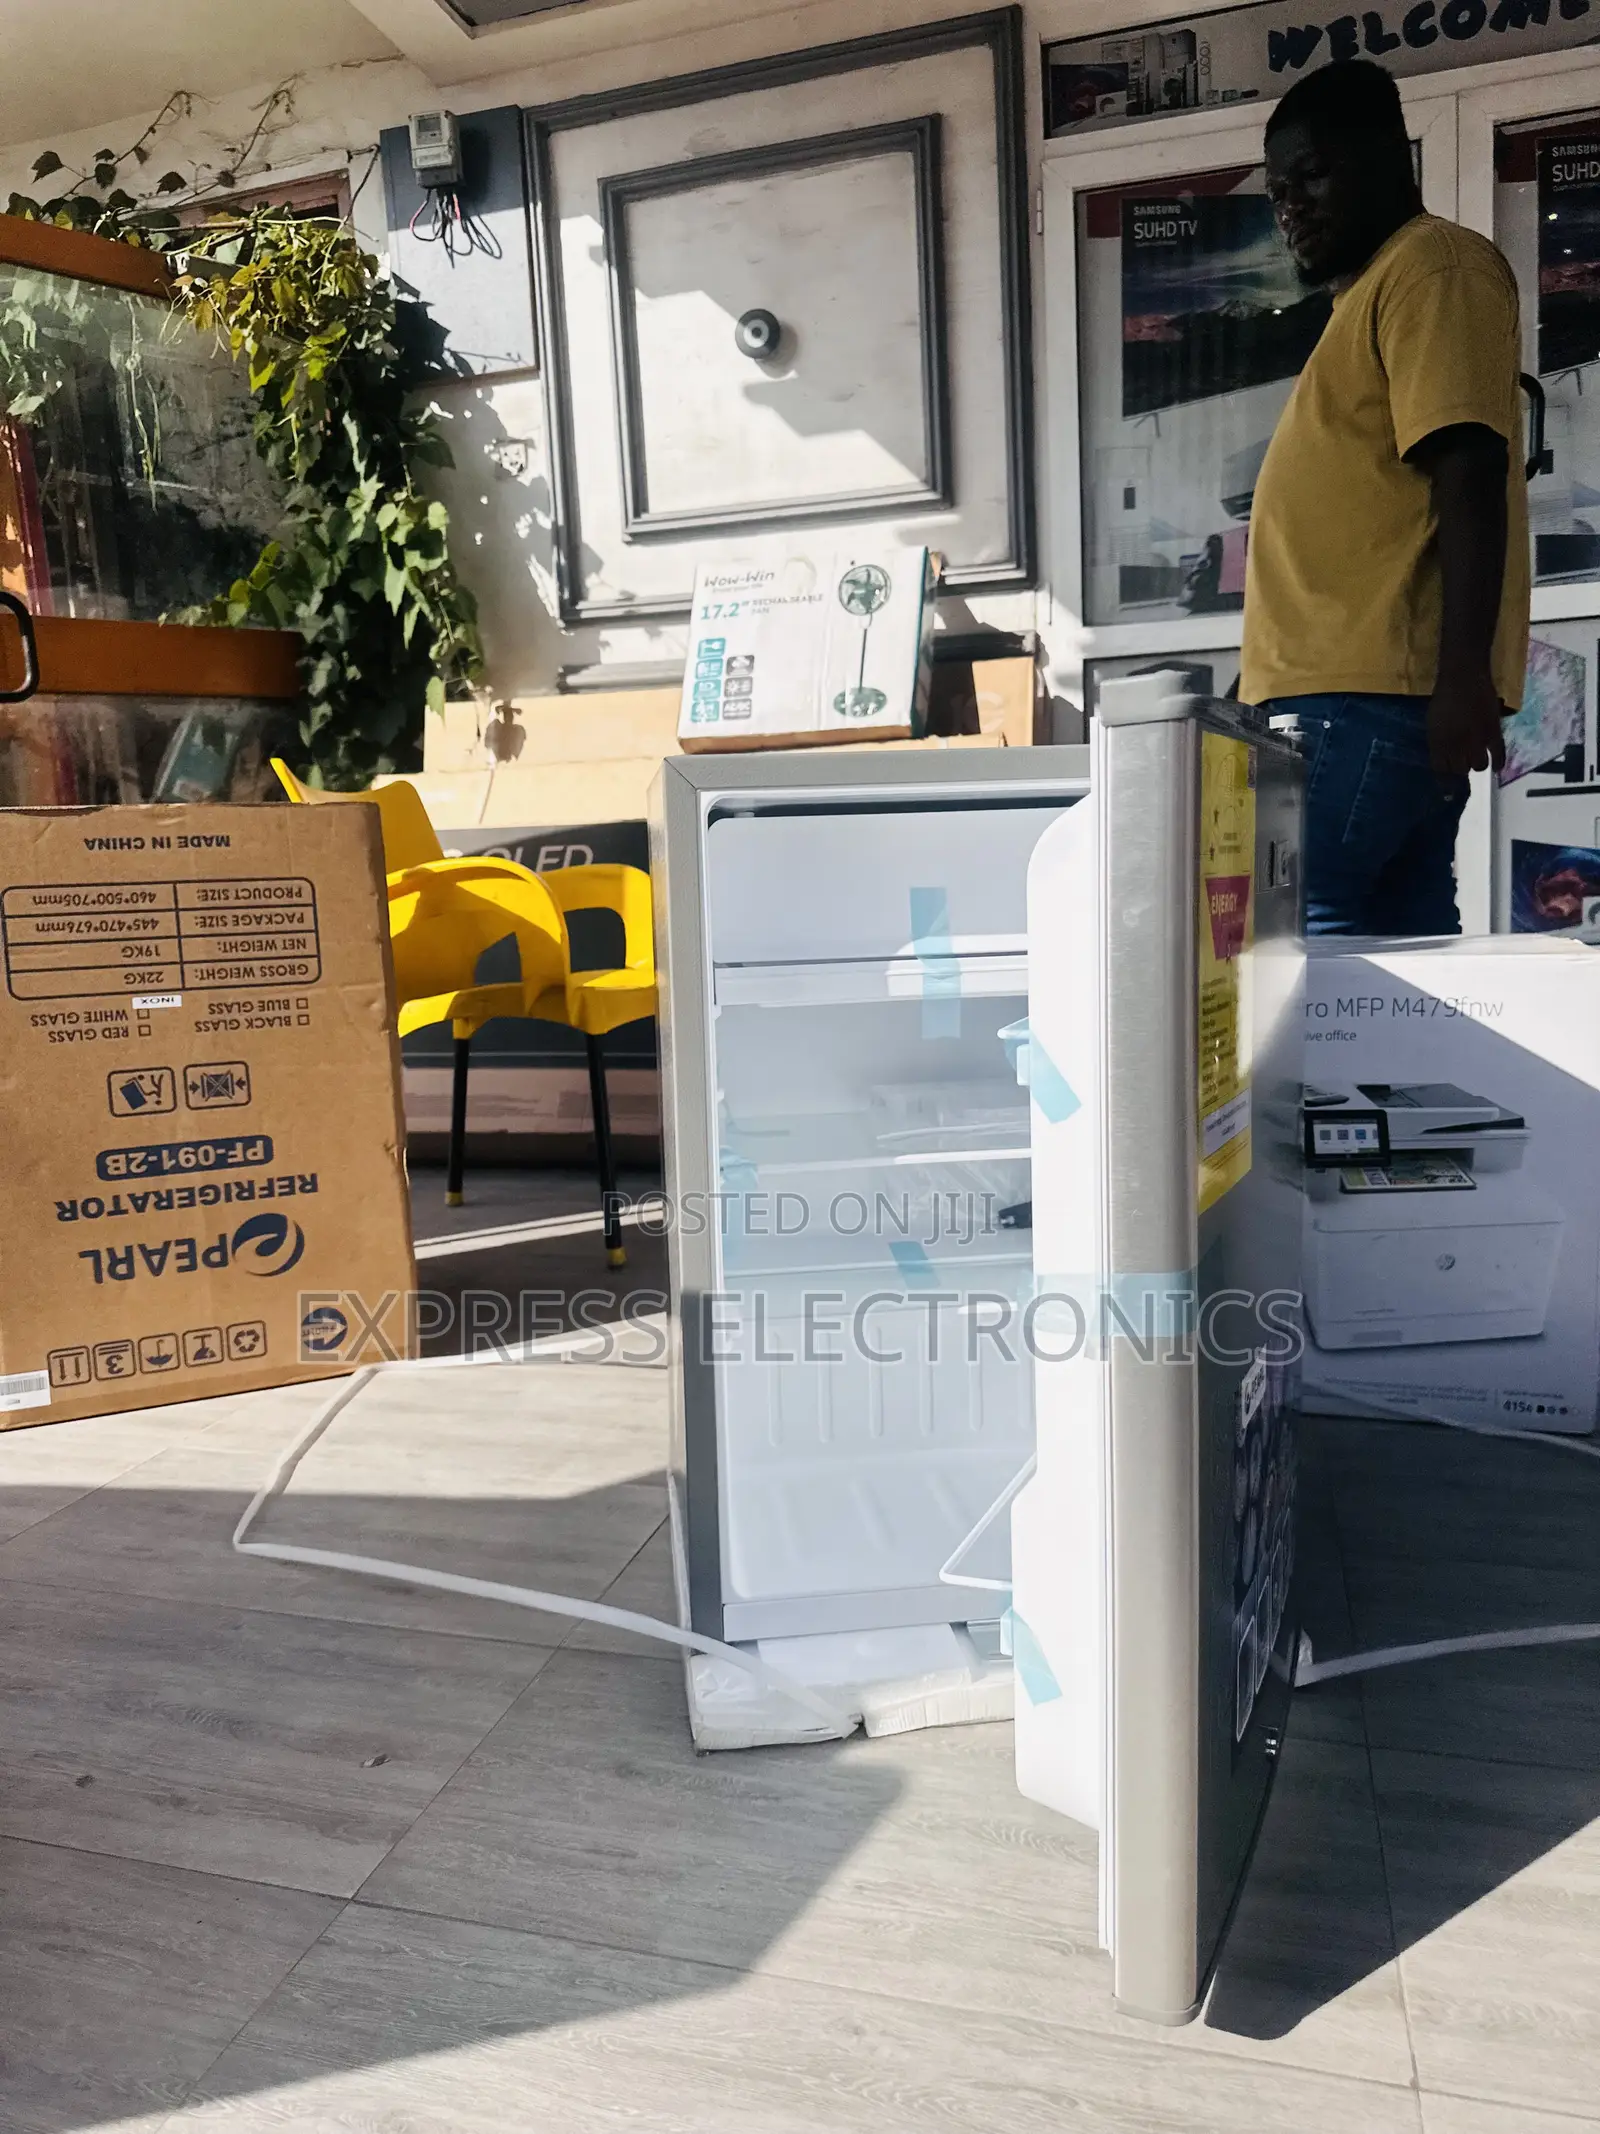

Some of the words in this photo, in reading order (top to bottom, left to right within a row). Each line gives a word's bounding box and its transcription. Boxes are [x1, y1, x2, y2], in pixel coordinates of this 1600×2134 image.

[1552, 144, 1600, 157] SAMSUN
[1552, 161, 1600, 182] SUHD
[1133, 205, 1181, 216] SAMSUNG
[84, 837, 145, 851] CHINA
[152, 836, 171, 849] IN
[178, 835, 230, 849] MADE
[197, 889, 229, 902] SIZE:
[236, 887, 302, 901] PRODUCT
[195, 915, 228, 928] SIZE:
[232, 912, 304, 926] PACKAGE
[217, 940, 277, 954] WEIGHT:
[282, 938, 307, 951] NET
[122, 945, 161, 959] 19KG
[195, 966, 255, 981] WEIGHT:
[260, 963, 308, 977] GROSS
[124, 971, 163, 985] 22KG
[208, 1001, 255, 1016] GLASS
[258, 998, 290, 1012] BLUE
[1336, 997, 1385, 1018] MFP
[1392, 996, 1504, 1019] M479fnw
[31, 1012, 79, 1027] GLASS
[84, 1009, 128, 1023] WHITE
[244, 1014, 291, 1030] BLACK
[103, 1025, 129, 1039] RED
[195, 1018, 240, 1034] GLASS
[48, 1028, 97, 1044] GLASS
[1325, 1029, 1357, 1042] office
[105, 1139, 265, 1175] PF-091-2B
[54, 1172, 318, 1222] REFRIGERATOR
[78, 1233, 230, 1285] PEARL
